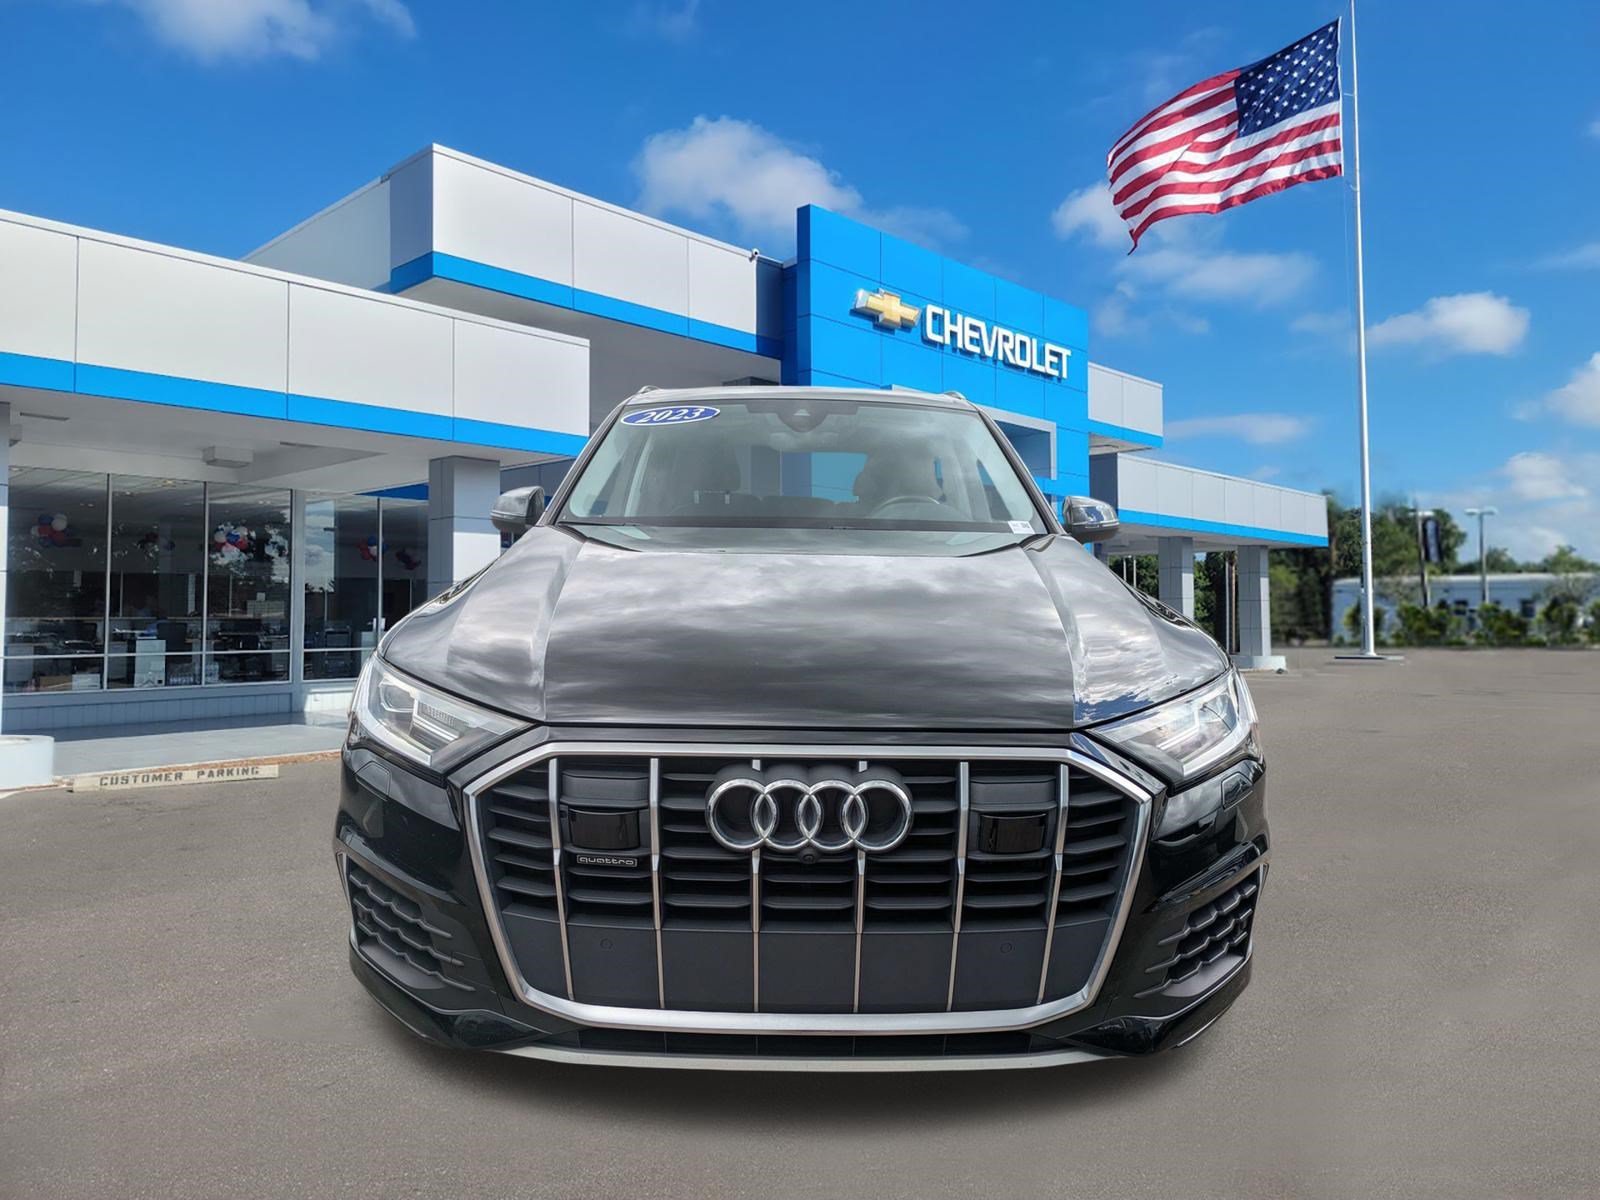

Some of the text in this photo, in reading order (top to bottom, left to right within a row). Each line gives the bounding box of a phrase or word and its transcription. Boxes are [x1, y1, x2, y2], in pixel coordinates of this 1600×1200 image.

[925, 304, 1072, 379] CHEVROLET
[635, 408, 704, 423] 2023
[100, 766, 260, 786] CUSTOMER PARKING
[579, 856, 634, 866] quattro
